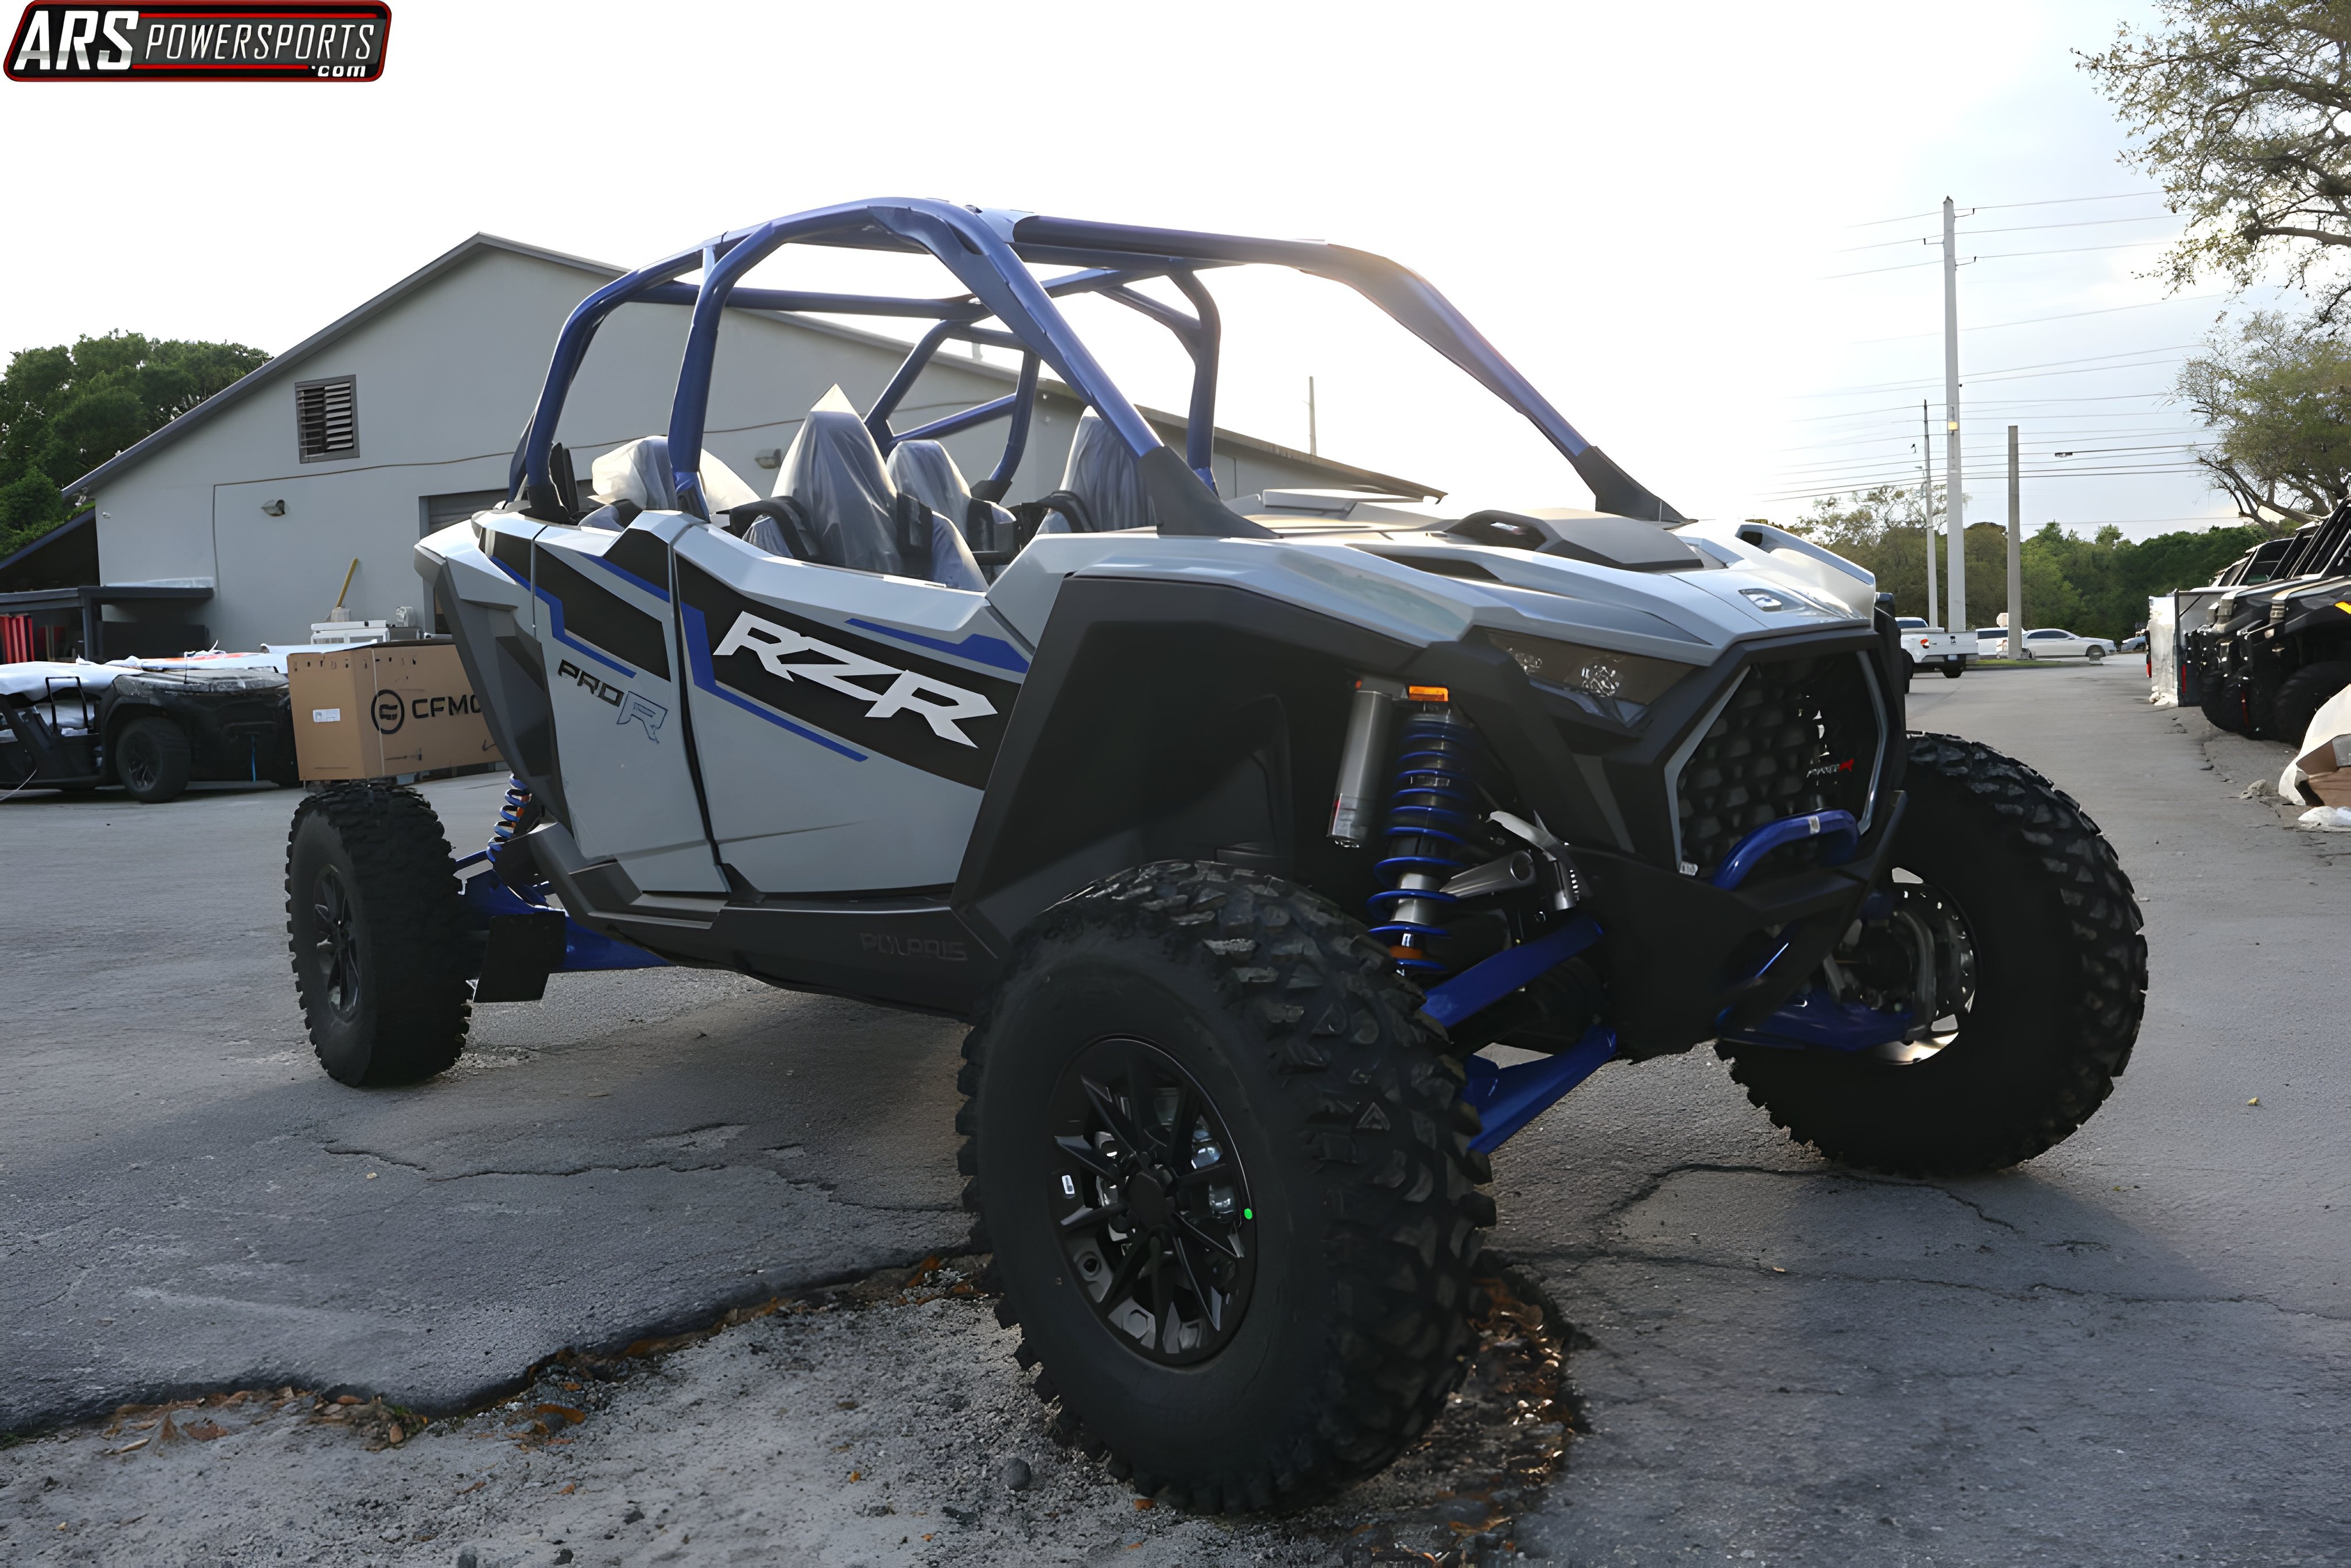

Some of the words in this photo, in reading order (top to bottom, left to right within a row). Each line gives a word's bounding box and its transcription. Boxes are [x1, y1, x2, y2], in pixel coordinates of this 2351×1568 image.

[558, 659, 624, 707] PRO
[713, 611, 998, 748] RZR
[860, 933, 968, 961] POLARIS
